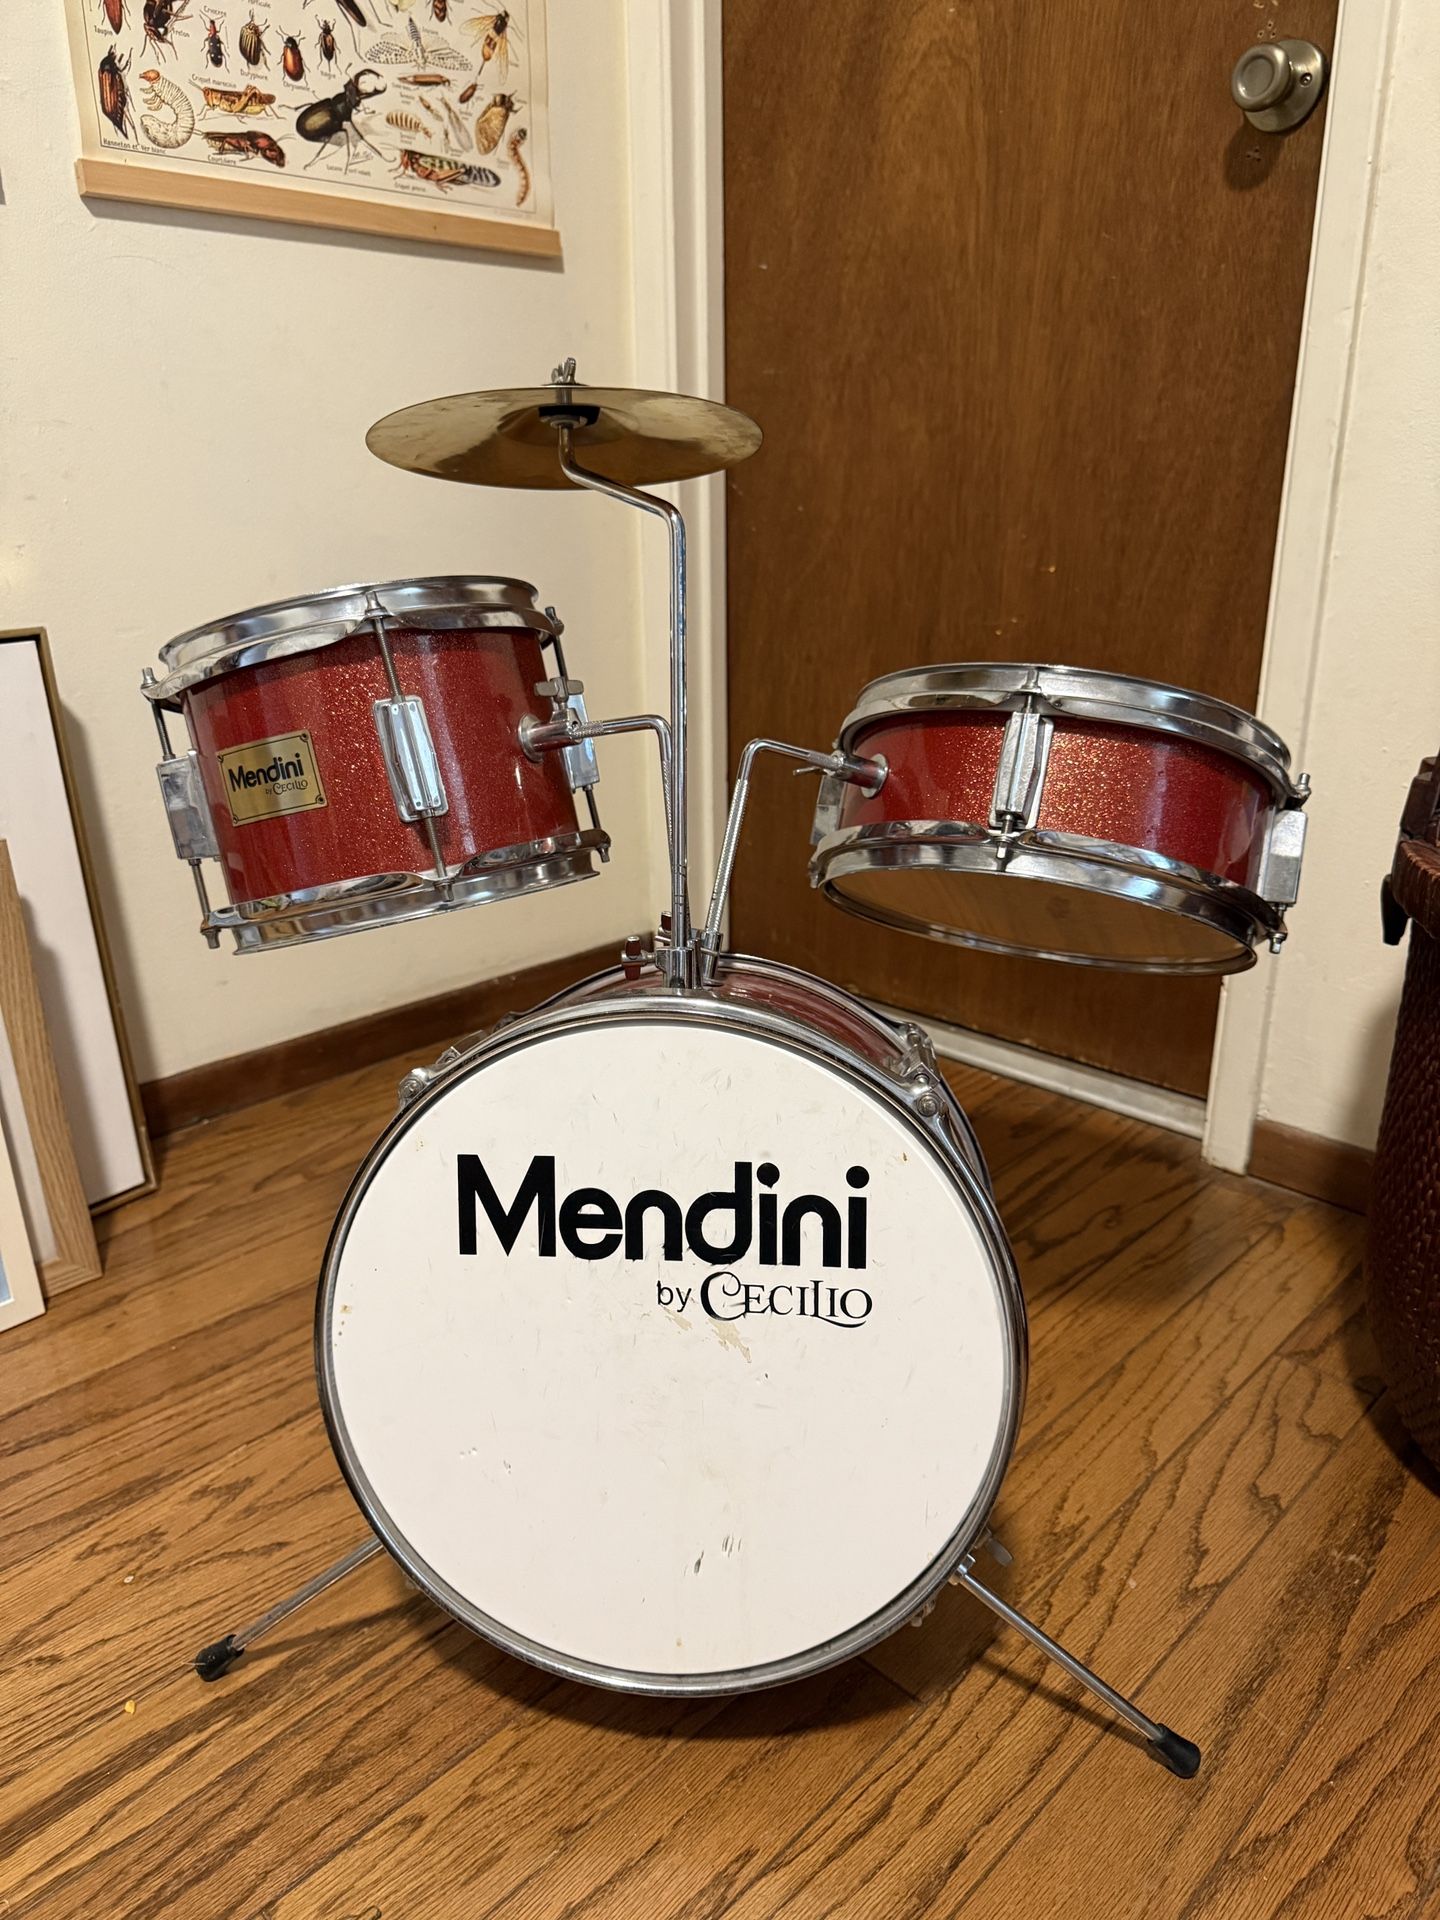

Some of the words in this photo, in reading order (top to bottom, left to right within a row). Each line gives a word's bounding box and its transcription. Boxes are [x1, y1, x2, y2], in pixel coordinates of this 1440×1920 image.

[228, 752, 305, 792] Mendini
[457, 1153, 870, 1270] Mendini
[656, 1280, 692, 1313] by
[700, 1271, 874, 1329] CECILIO
